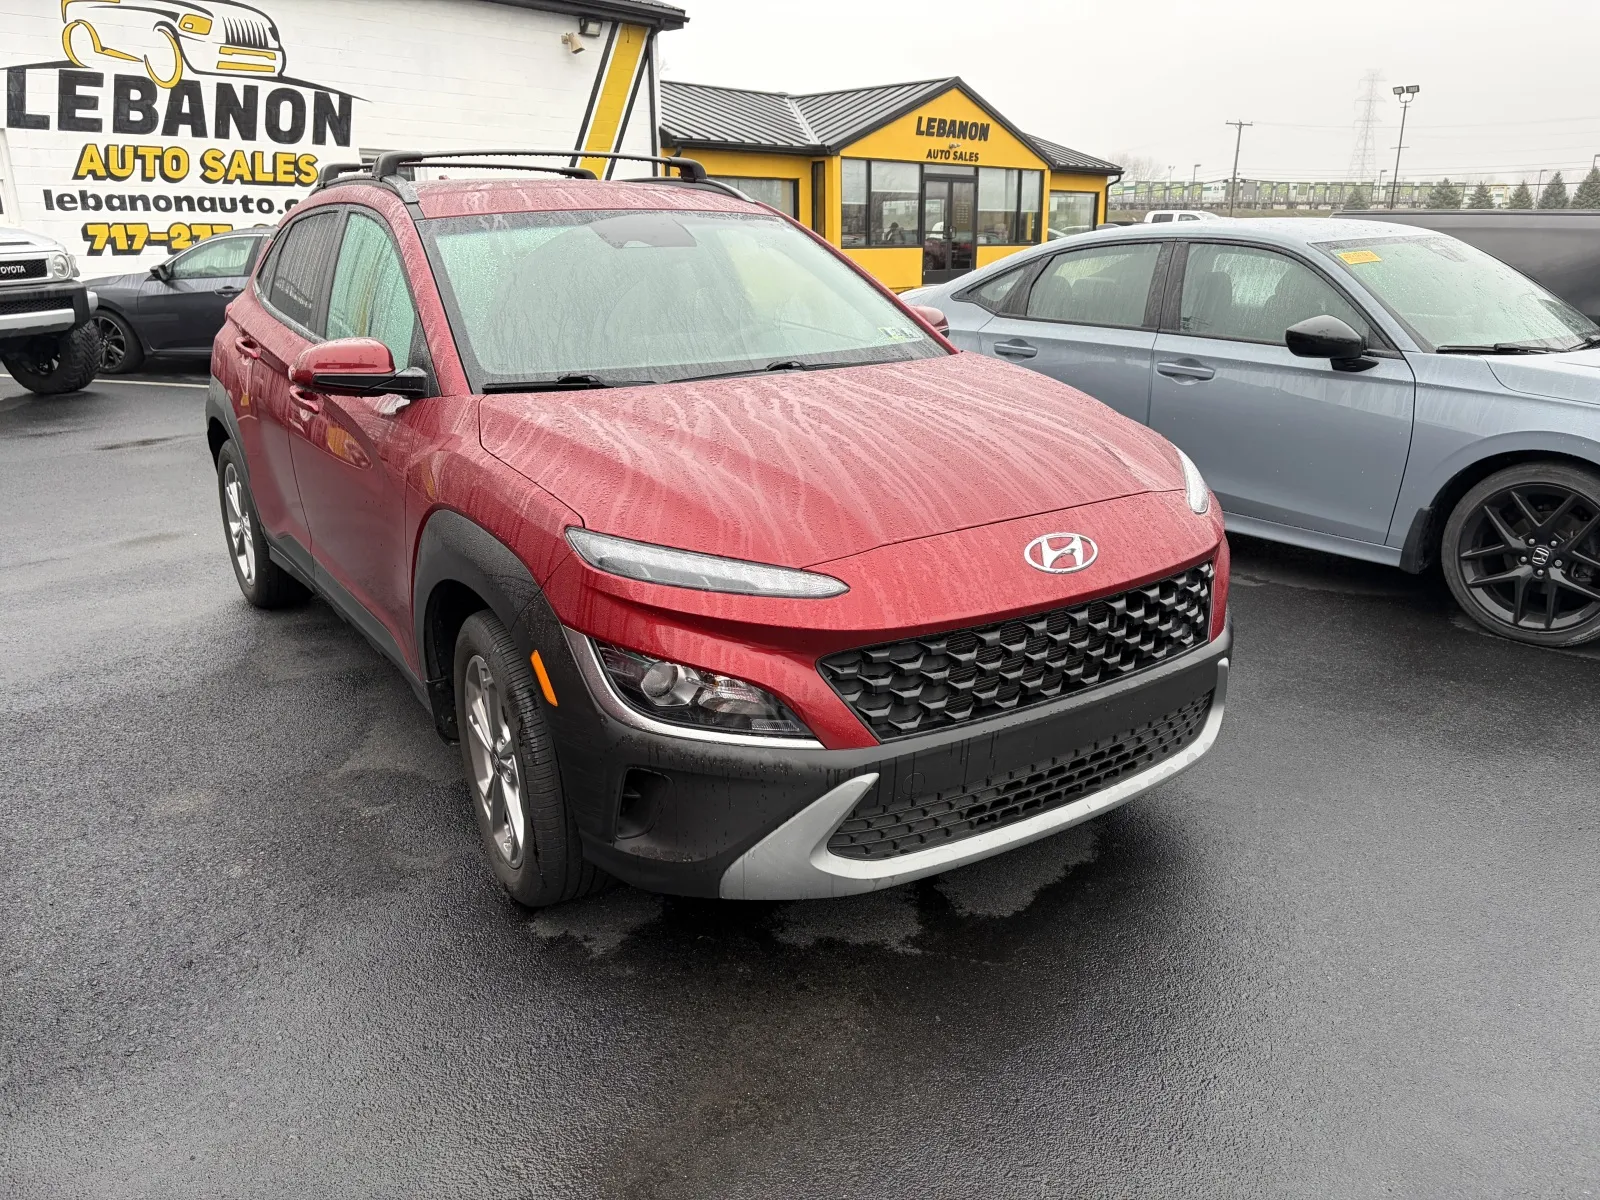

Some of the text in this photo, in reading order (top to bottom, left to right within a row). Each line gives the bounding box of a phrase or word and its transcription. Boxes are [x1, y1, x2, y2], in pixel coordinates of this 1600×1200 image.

[7, 68, 353, 147] LEBANON
[916, 116, 990, 141] LEBANON
[72, 144, 319, 187] AUTO SALES
[926, 149, 979, 162] AUTO SALES
[0, 265, 26, 274] OYOTA
